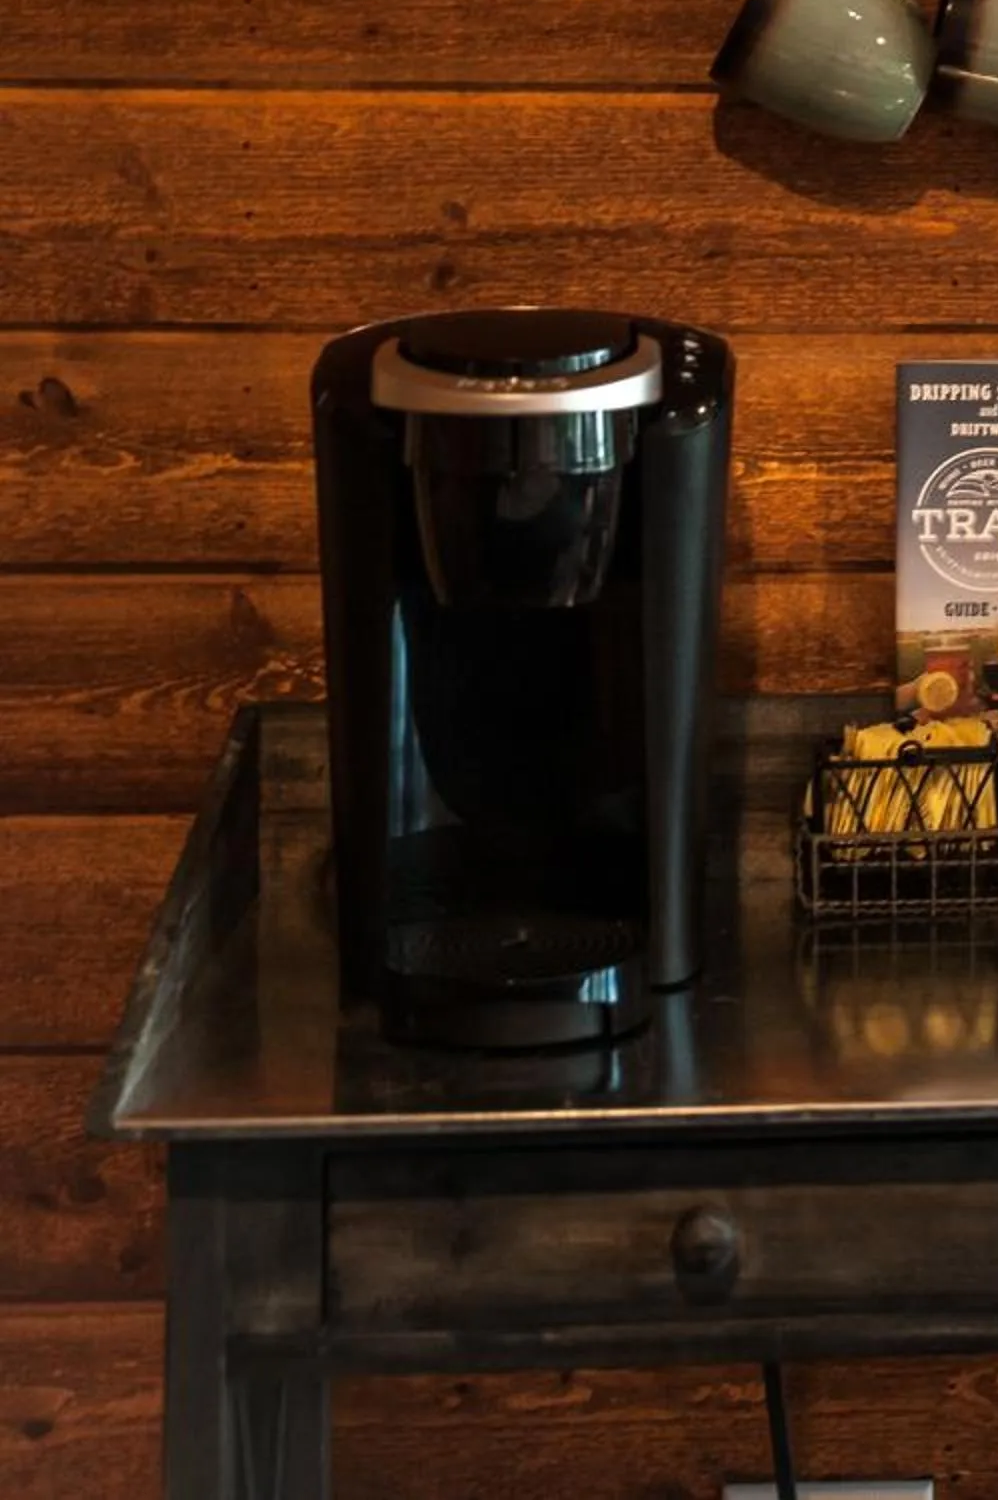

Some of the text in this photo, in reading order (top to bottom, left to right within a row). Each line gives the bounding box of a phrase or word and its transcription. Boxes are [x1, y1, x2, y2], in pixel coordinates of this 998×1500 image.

[909, 383, 991, 401] DRIPPING
[979, 403, 998, 417] and
[944, 602, 990, 618] GUIDE
